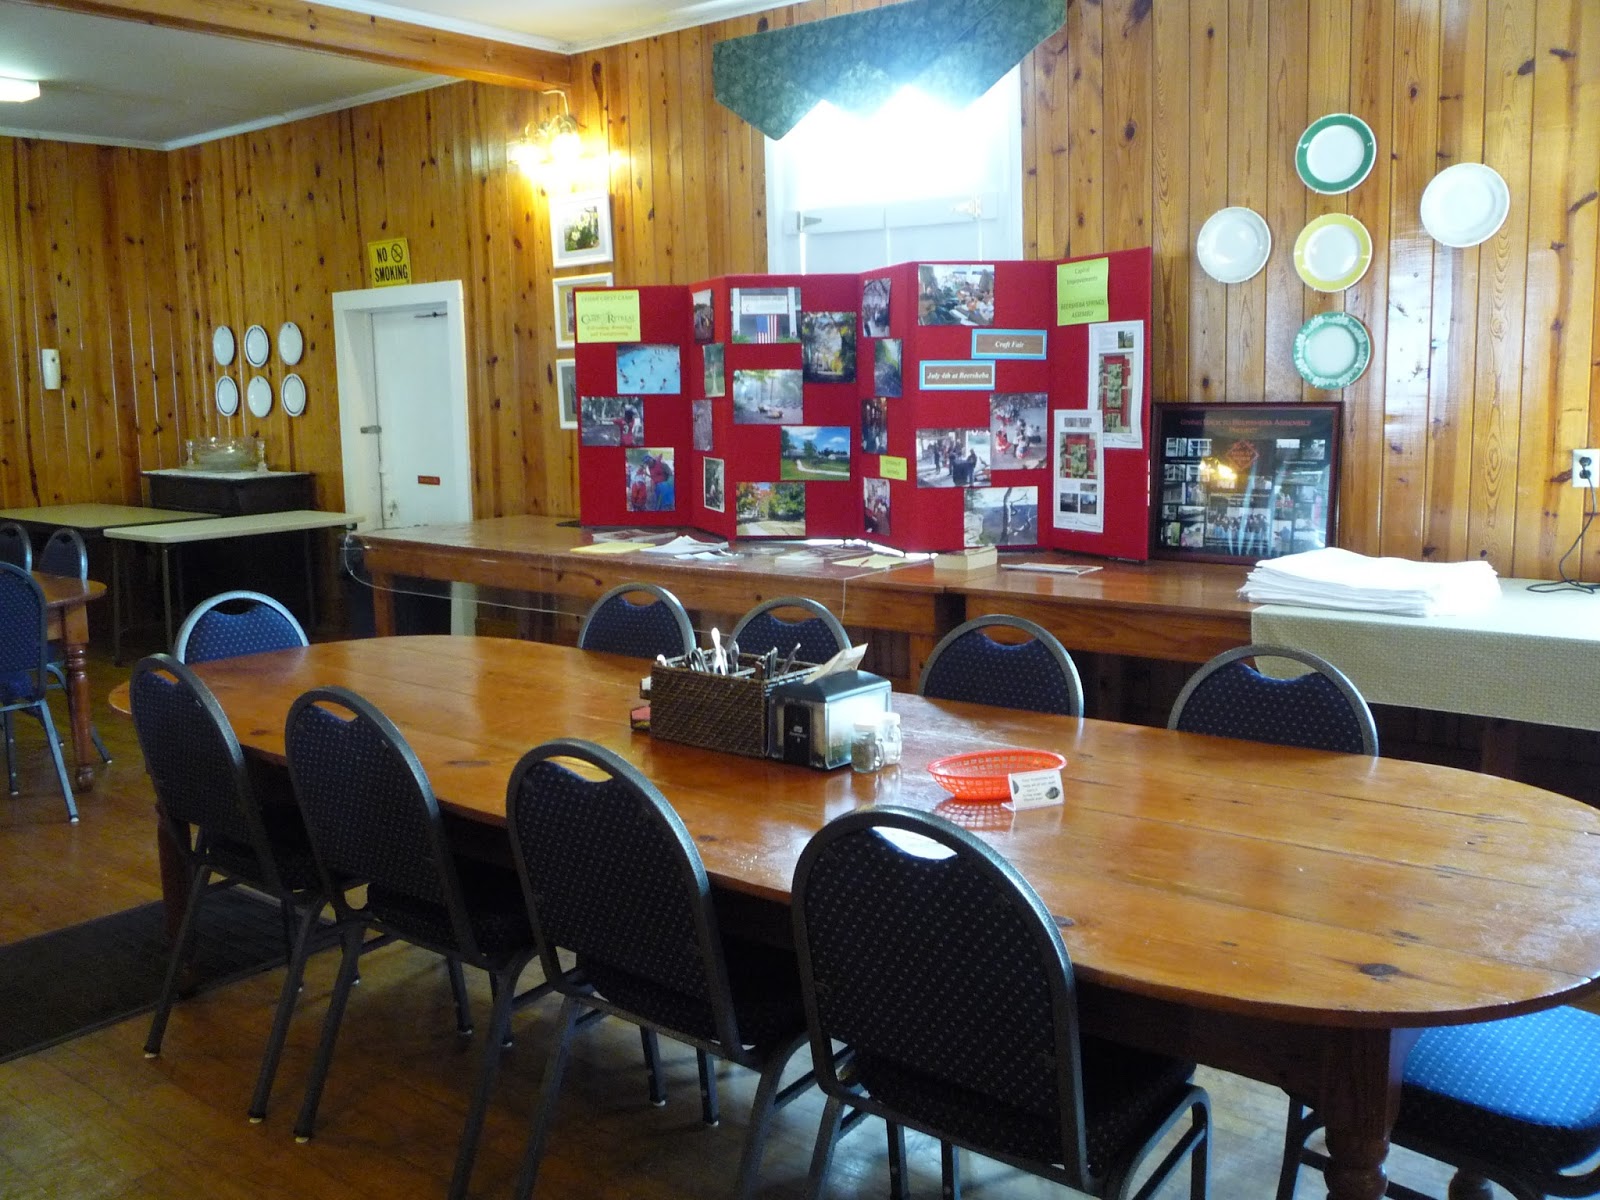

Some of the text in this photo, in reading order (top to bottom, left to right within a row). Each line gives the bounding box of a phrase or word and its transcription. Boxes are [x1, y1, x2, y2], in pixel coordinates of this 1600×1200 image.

[376, 247, 388, 263] NO
[374, 264, 408, 282] SMOKING
[926, 372, 940, 380] July
